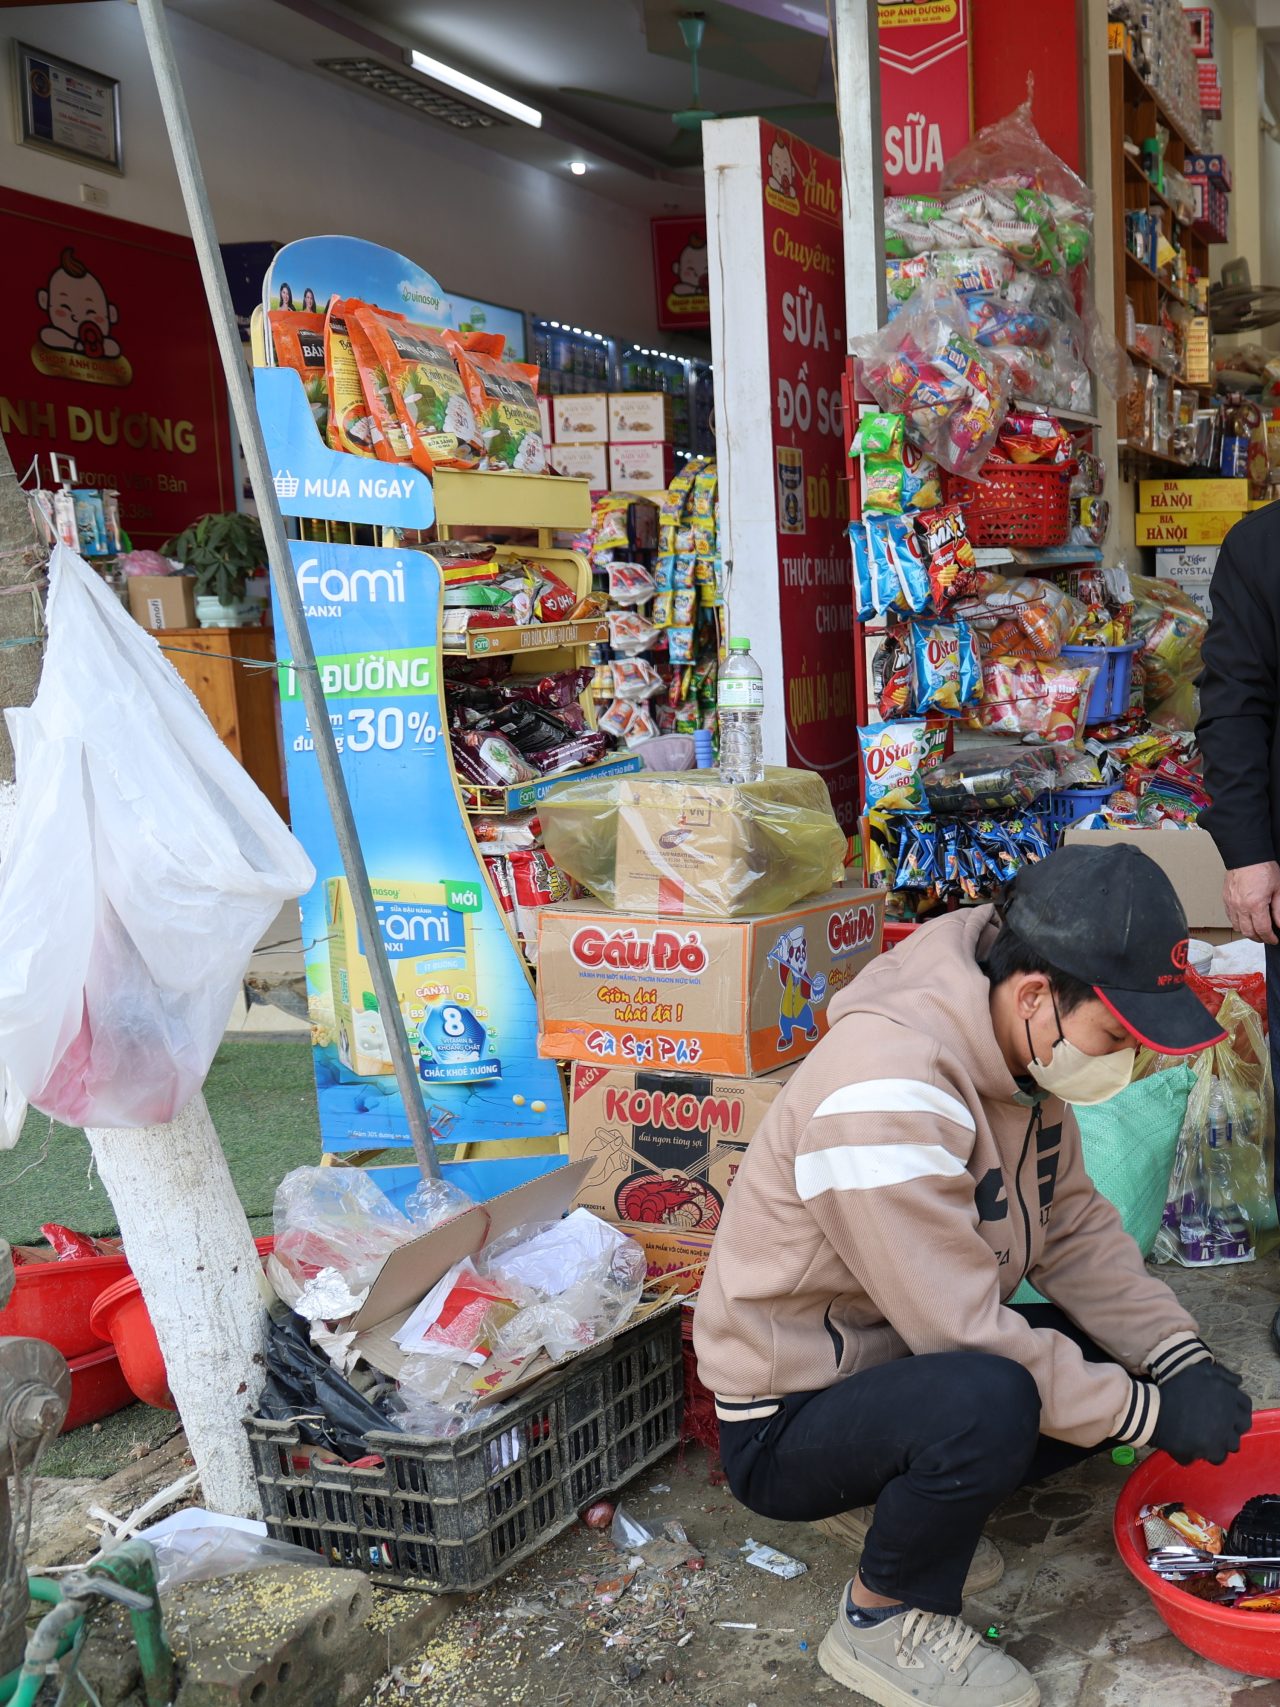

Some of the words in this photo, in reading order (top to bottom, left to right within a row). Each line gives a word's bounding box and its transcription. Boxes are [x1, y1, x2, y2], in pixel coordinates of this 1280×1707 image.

[877, 9, 896, 18] HOP
[884, 112, 945, 176] SỮA
[782, 285, 830, 352] SỮA
[303, 343, 325, 358] BÁN
[777, 361, 812, 432] ĐỒ
[0, 396, 56, 439] NH
[67, 406, 197, 454] DƯƠNG
[305, 479, 351, 498] MUA
[358, 479, 415, 498] NGAY
[1163, 482, 1179, 491] BIA
[1151, 493, 1168, 507] HÀ
[1170, 494, 1193, 509] NỘI
[1159, 515, 1174, 524] BIA
[1147, 526, 1164, 540] HÀ
[1166, 527, 1188, 542] NỘI
[1187, 555, 1206, 565] Tiger
[783, 552, 813, 594] THỰC
[1170, 567, 1214, 576] CRYSTAL
[321, 655, 430, 693] ĐƯỜNG
[347, 707, 436, 752] 30%
[867, 741, 916, 778] O'Star
[373, 888, 400, 899] nasoy
[452, 889, 478, 906] MỚI
[385, 942, 403, 952] NXI
[571, 927, 650, 970] Gấu
[652, 930, 707, 974] Đỏ
[416, 985, 450, 998] CANXI
[455, 992, 470, 1001] D3
[597, 986, 630, 1004] Giòn
[634, 987, 657, 1004] dai
[410, 1009, 425, 1018] B9
[615, 1004, 648, 1021] nhai
[652, 1004, 673, 1022] đã
[442, 1007, 465, 1037] 8
[407, 1031, 419, 1039] Zn
[587, 1030, 616, 1056] Gà
[621, 1034, 653, 1062] Sợi
[657, 1035, 702, 1062] Phở
[424, 1067, 446, 1078] CHẮC
[469, 1064, 498, 1076] XƯƠNG
[578, 1068, 600, 1089] MỚI
[605, 1087, 742, 1135] KOKOMI
[638, 1132, 652, 1142] dai
[652, 1136, 672, 1147] ngon
[647, 1260, 664, 1276] ảo
